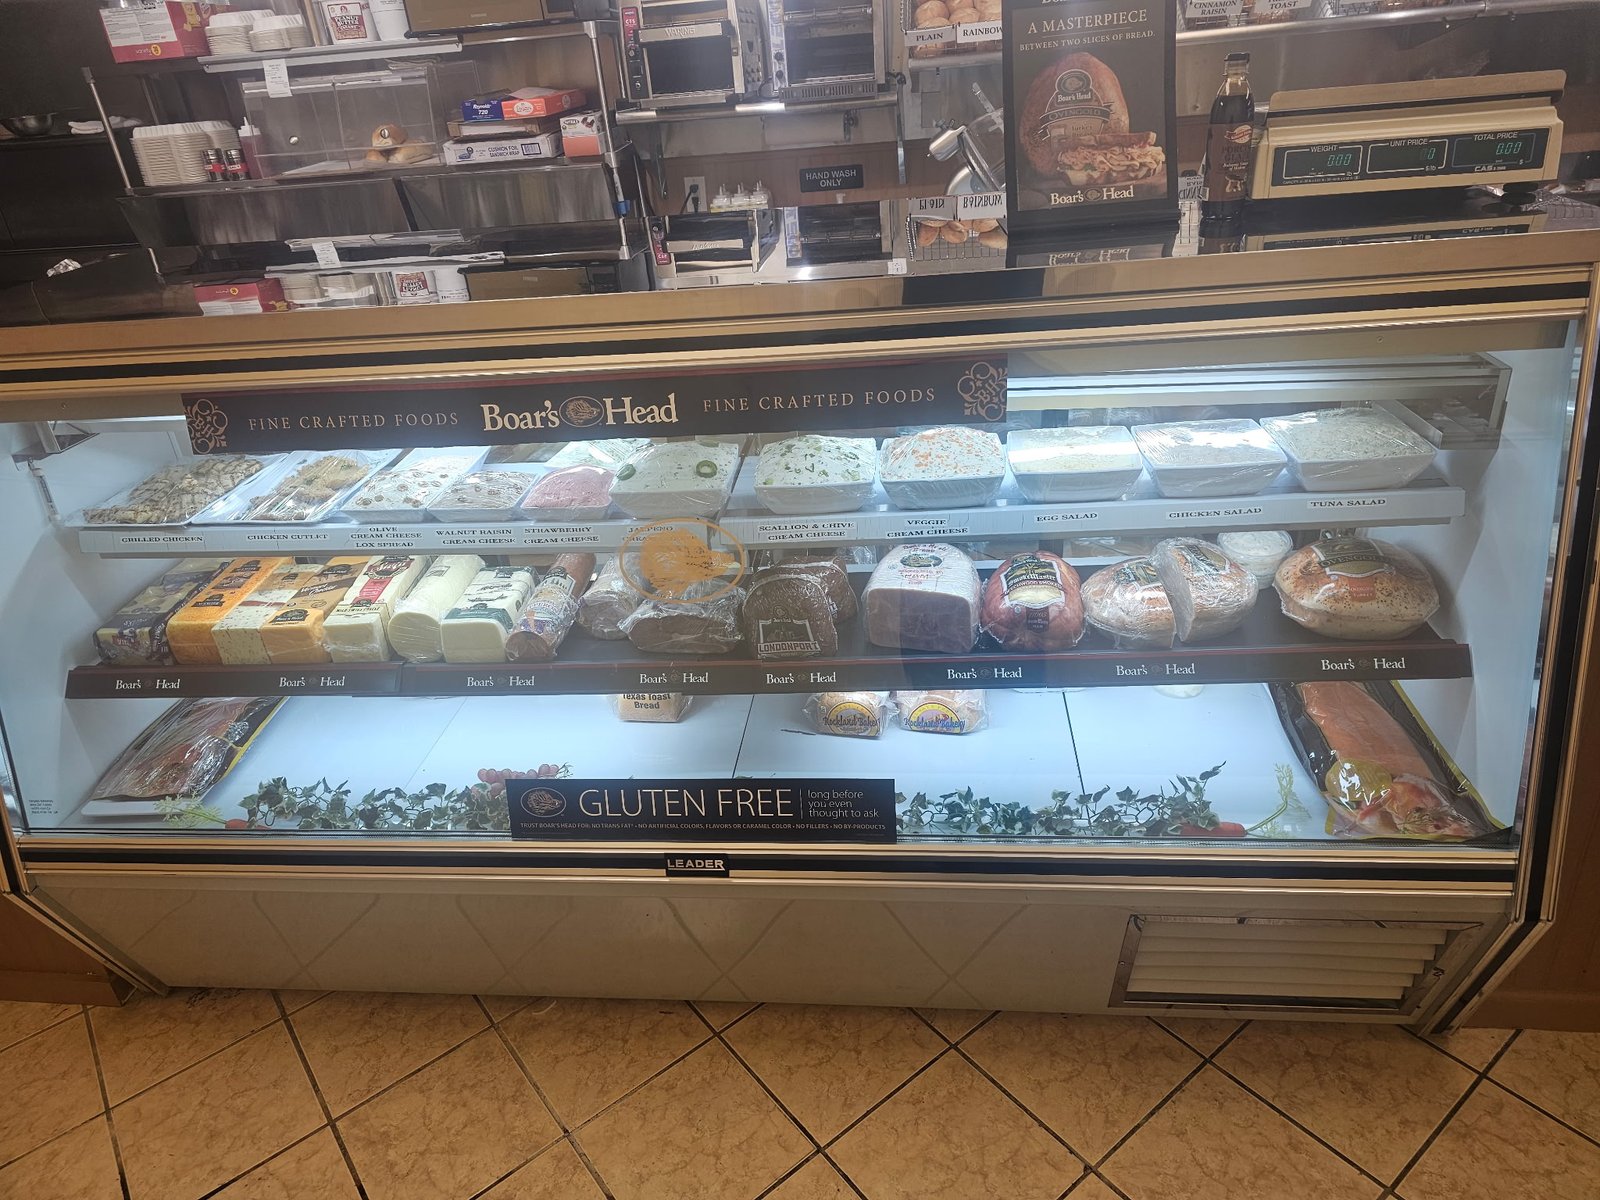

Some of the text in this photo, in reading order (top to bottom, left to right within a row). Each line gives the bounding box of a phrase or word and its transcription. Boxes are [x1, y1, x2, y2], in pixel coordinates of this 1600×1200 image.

[1194, 1, 1237, 10] CINNAMON
[1269, 1, 1298, 10] TOAST
[1201, 8, 1227, 16] RAISIN
[1028, 9, 1148, 34] A MASTERPIECE
[916, 32, 944, 41] PLAIN
[1020, 40, 1059, 51] BETWEEN
[1061, 38, 1081, 47] TWO
[1082, 35, 1110, 45] SLICES
[1112, 34, 1124, 42] OF
[1407, 138, 1428, 146] PRICE
[1474, 133, 1495, 141] TOTAL
[1310, 145, 1338, 153] WEIGHT
[806, 169, 857, 180] HAND WASH
[820, 178, 842, 187] ONLY
[1050, 184, 1134, 205] Boar's Head
[703, 387, 936, 413] FINE CRAFTED FOODS
[480, 392, 679, 432] Boar's Head
[248, 411, 459, 431] FINE CRAFTED FOODS
[1310, 499, 1386, 508] TUNA SALAD
[1061, 512, 1098, 521] SALAD
[1168, 507, 1262, 519] CHICKEN SALAD
[524, 526, 592, 534] STRAWBERRY
[759, 523, 809, 532] SCALLION
[822, 521, 855, 529] CHIVE
[768, 530, 846, 541] CREAM CHEESE
[886, 527, 969, 538] CREAM CHEESE
[523, 535, 600, 545] CREAM CHEESE
[759, 642, 820, 653] LONDONPORT
[1116, 662, 1196, 676] Boar's Head
[1321, 657, 1406, 671] Boar's Head
[639, 672, 709, 684] Boar's Head
[766, 672, 836, 684] Boar's Head
[947, 666, 1022, 680] Boar's Head
[115, 679, 181, 690] Boar's Head
[279, 676, 345, 688] Boar's Head
[466, 675, 535, 688] Boar's Head
[634, 701, 660, 709] Bread
[823, 715, 857, 727] Rockland
[904, 716, 966, 730] Rockland Bakery
[808, 789, 864, 800] long before
[579, 788, 794, 818] GLUTEN FREE
[808, 800, 853, 809] you even
[809, 808, 879, 820] thought to ask
[667, 859, 725, 870] LEADER
